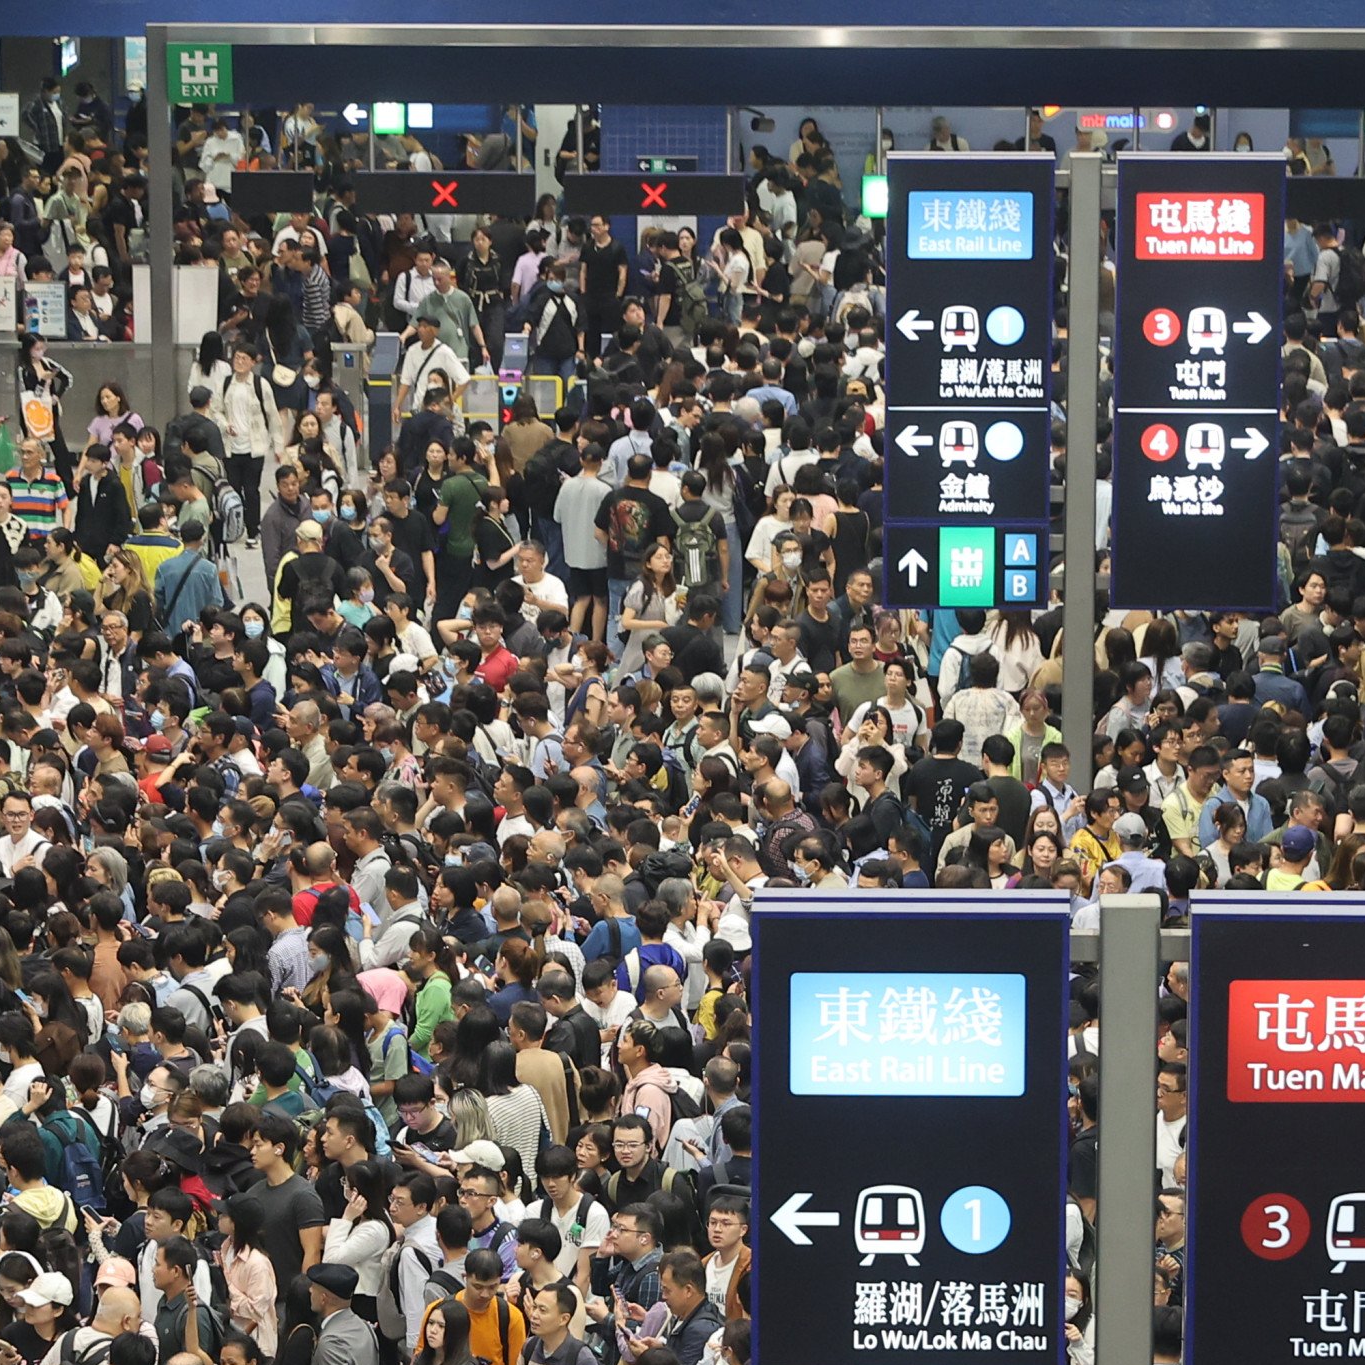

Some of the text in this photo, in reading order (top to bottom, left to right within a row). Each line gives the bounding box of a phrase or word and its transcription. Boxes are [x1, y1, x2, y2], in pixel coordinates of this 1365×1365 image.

[181, 85, 218, 97] EXIT
[922, 199, 1021, 233] 東鐵綫
[1150, 199, 1251, 235] 屯馬綫
[919, 237, 1022, 252] East Rail Line
[1146, 237, 1253, 255] Tuen Ma Line
[1153, 314, 1170, 341] 3
[1176, 360, 1226, 386] 屯門
[940, 386, 1043, 398] Lo Wu/Lok Ma Chau
[1169, 386, 1226, 400] Tuen Mun
[1150, 430, 1169, 454] 4
[940, 473, 989, 500] 金鐘
[939, 500, 994, 514] Admiralty
[1162, 502, 1223, 515] Wu Kai Sha
[1013, 540, 1030, 561] A
[951, 575, 982, 587] EXIT
[1014, 575, 1028, 597] B
[812, 986, 1003, 1048] 東鐵綫
[810, 1056, 1005, 1084] East Rail Line
[1248, 1062, 1323, 1091] Tuen
[964, 1199, 981, 1239] 1
[1260, 1206, 1290, 1248] 3
[853, 1281, 1045, 1328] 羅湖/落馬洲
[853, 1329, 1047, 1351] Lo Wu/Lok Ma Chau
[1290, 1337, 1342, 1358] Tuen
